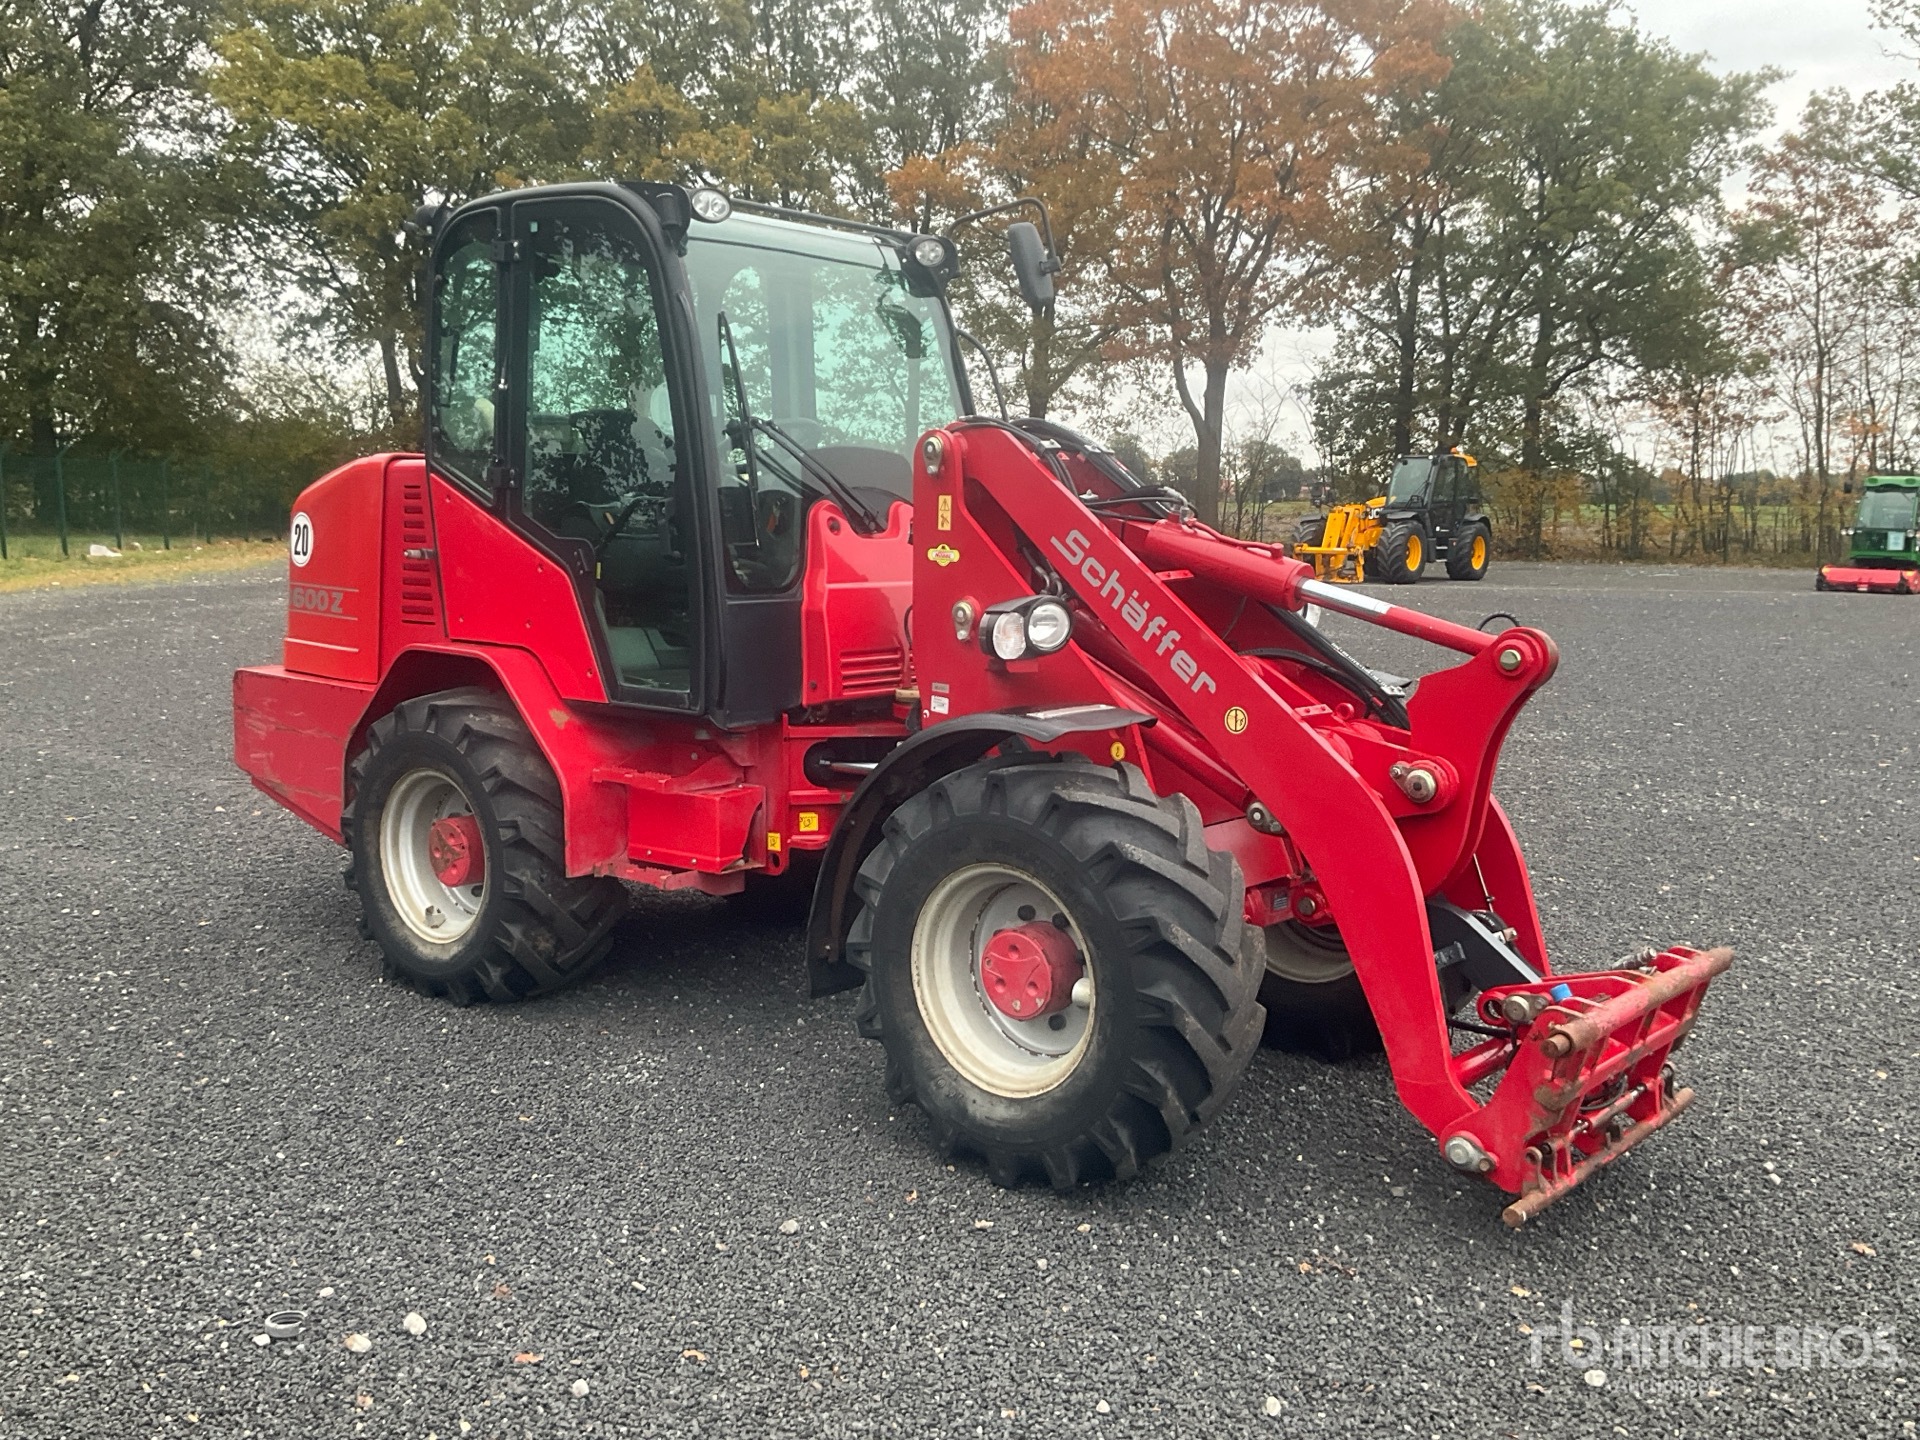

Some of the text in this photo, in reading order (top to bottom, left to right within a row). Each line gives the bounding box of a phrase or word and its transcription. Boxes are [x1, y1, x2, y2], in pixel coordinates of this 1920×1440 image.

[1368, 507, 1384, 519] JC
[294, 523, 309, 556] 20
[1050, 529, 1216, 694] Schäffer
